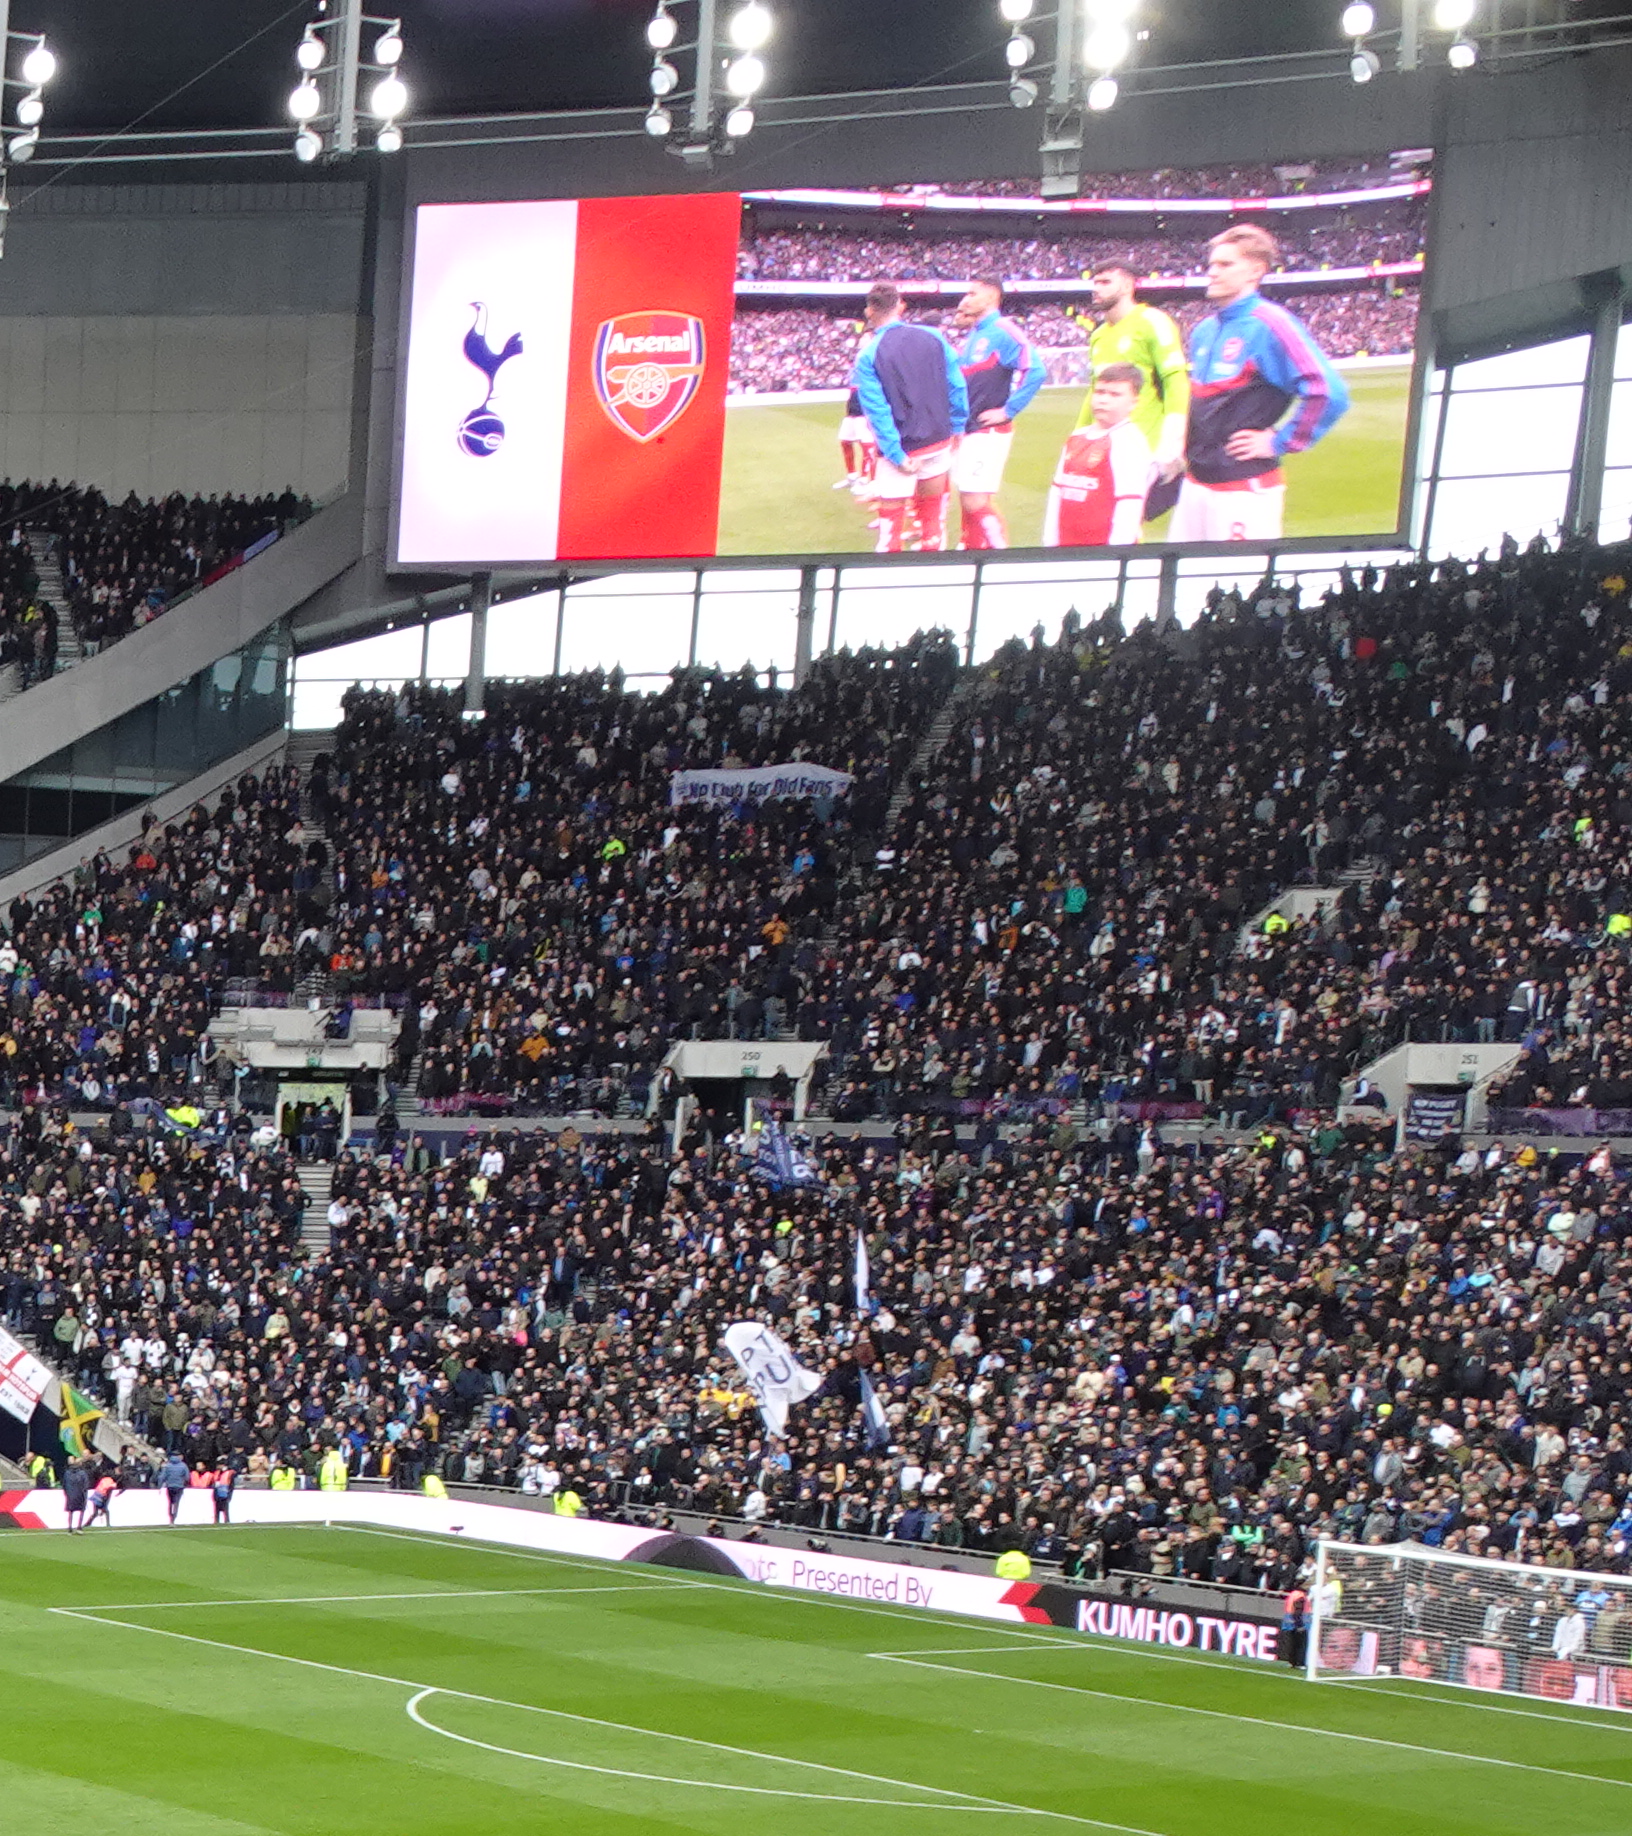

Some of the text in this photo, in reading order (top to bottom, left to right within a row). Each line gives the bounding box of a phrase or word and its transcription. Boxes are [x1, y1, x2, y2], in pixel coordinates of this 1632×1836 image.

[608, 330, 691, 354] Arsenal
[793, 1561, 898, 1602] Presented
[905, 1576, 934, 1608] By
[1077, 1599, 1277, 1662] KUMHO TYRE
